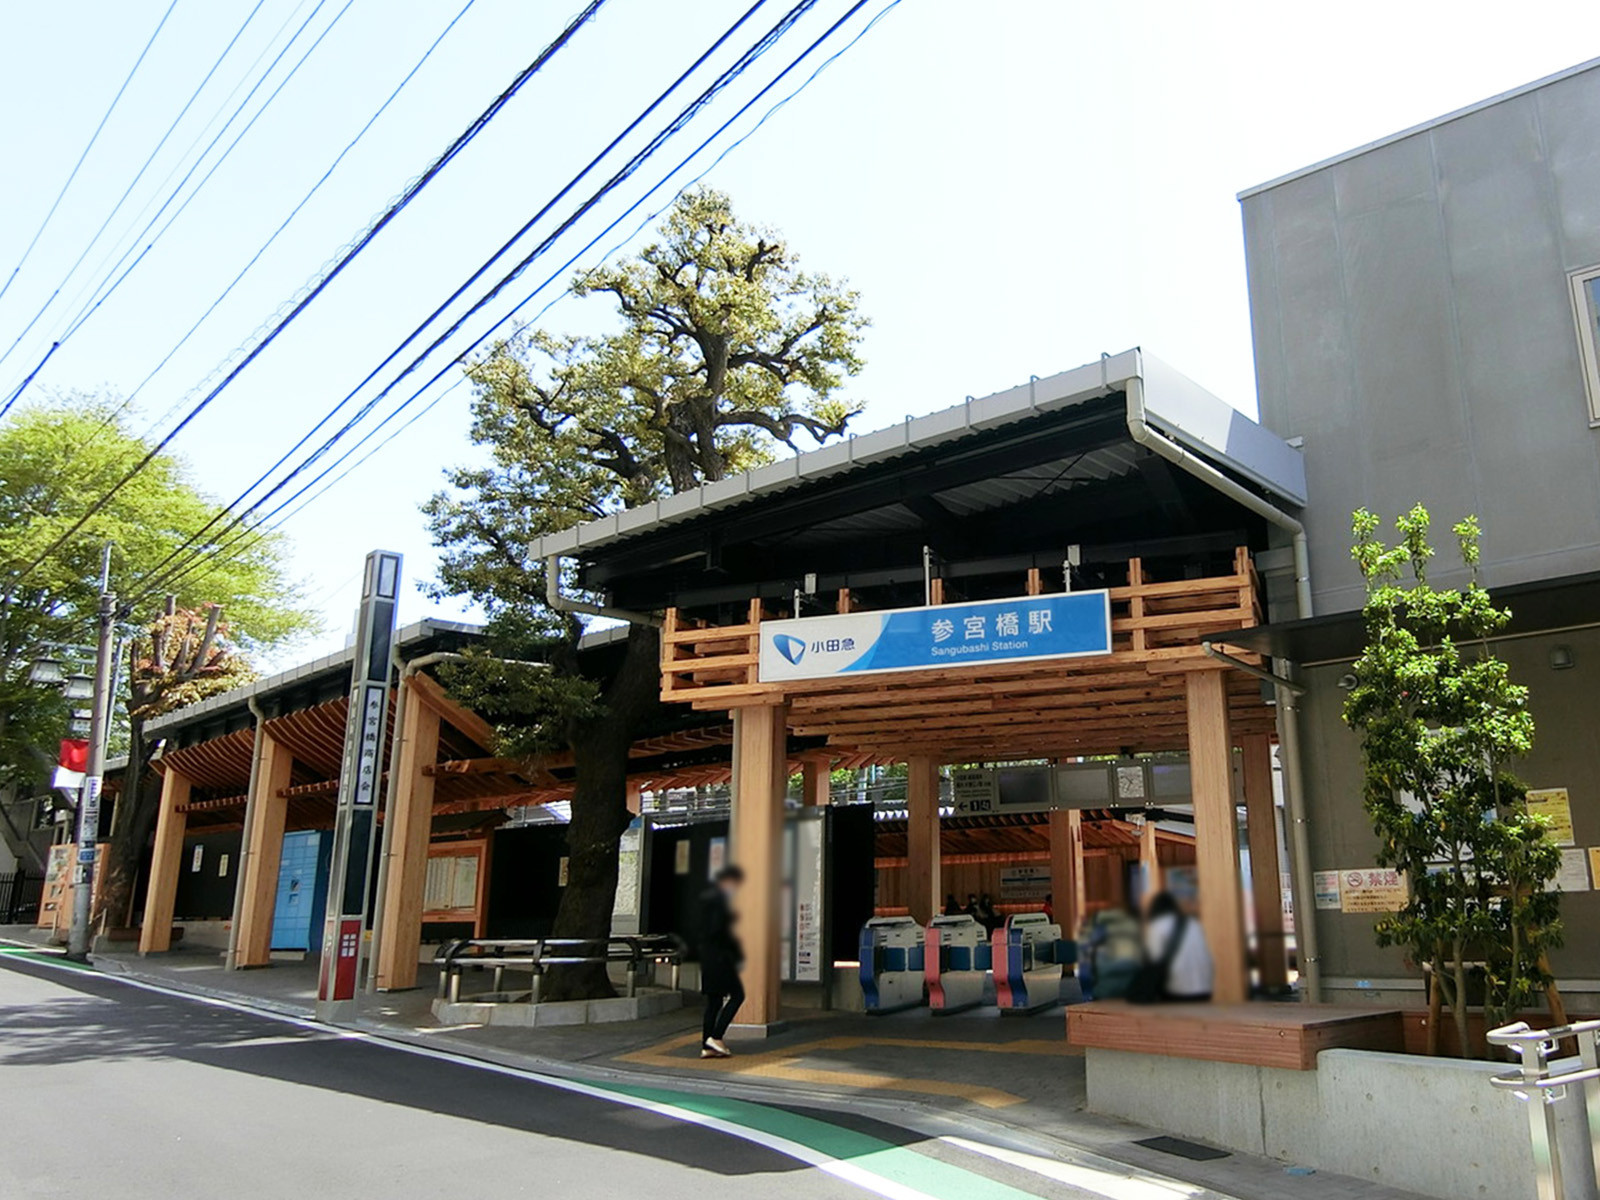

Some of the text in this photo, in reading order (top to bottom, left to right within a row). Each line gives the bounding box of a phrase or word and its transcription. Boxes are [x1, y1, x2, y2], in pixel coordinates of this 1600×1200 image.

[931, 609, 1053, 643] 参宮橋駅
[811, 638, 855, 653] 小田急
[931, 640, 1028, 657] Sangubashi Station
[360, 700, 379, 791] 参宮橋商店会
[1368, 871, 1399, 886] 禁煙
